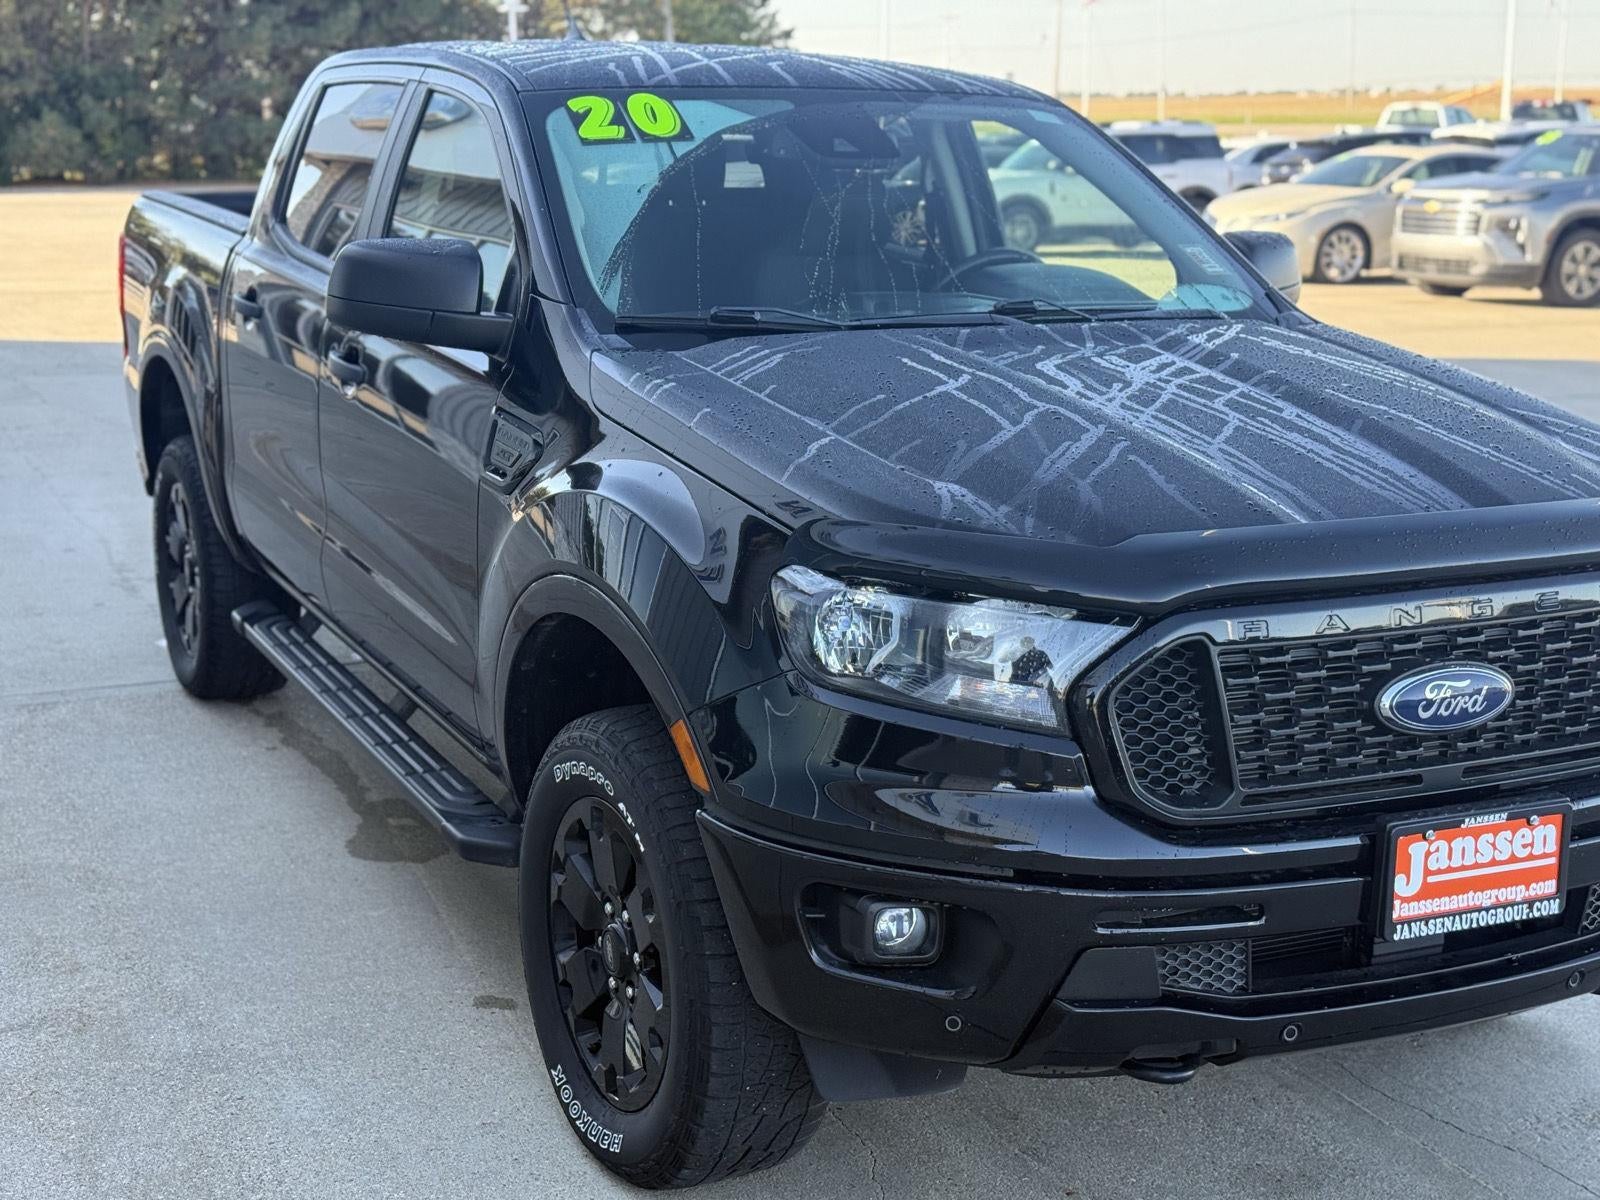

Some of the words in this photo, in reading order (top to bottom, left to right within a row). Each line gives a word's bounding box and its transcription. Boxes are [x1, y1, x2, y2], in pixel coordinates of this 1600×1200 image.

[567, 93, 681, 140] 20
[1418, 679, 1488, 719] Ford
[1460, 812, 1508, 829] JANSSEN
[1394, 823, 1556, 898] Janssen
[1392, 878, 1556, 919] Janssenautogroup.com
[1393, 898, 1561, 941] JANSSENAUTOGROUP.COM
